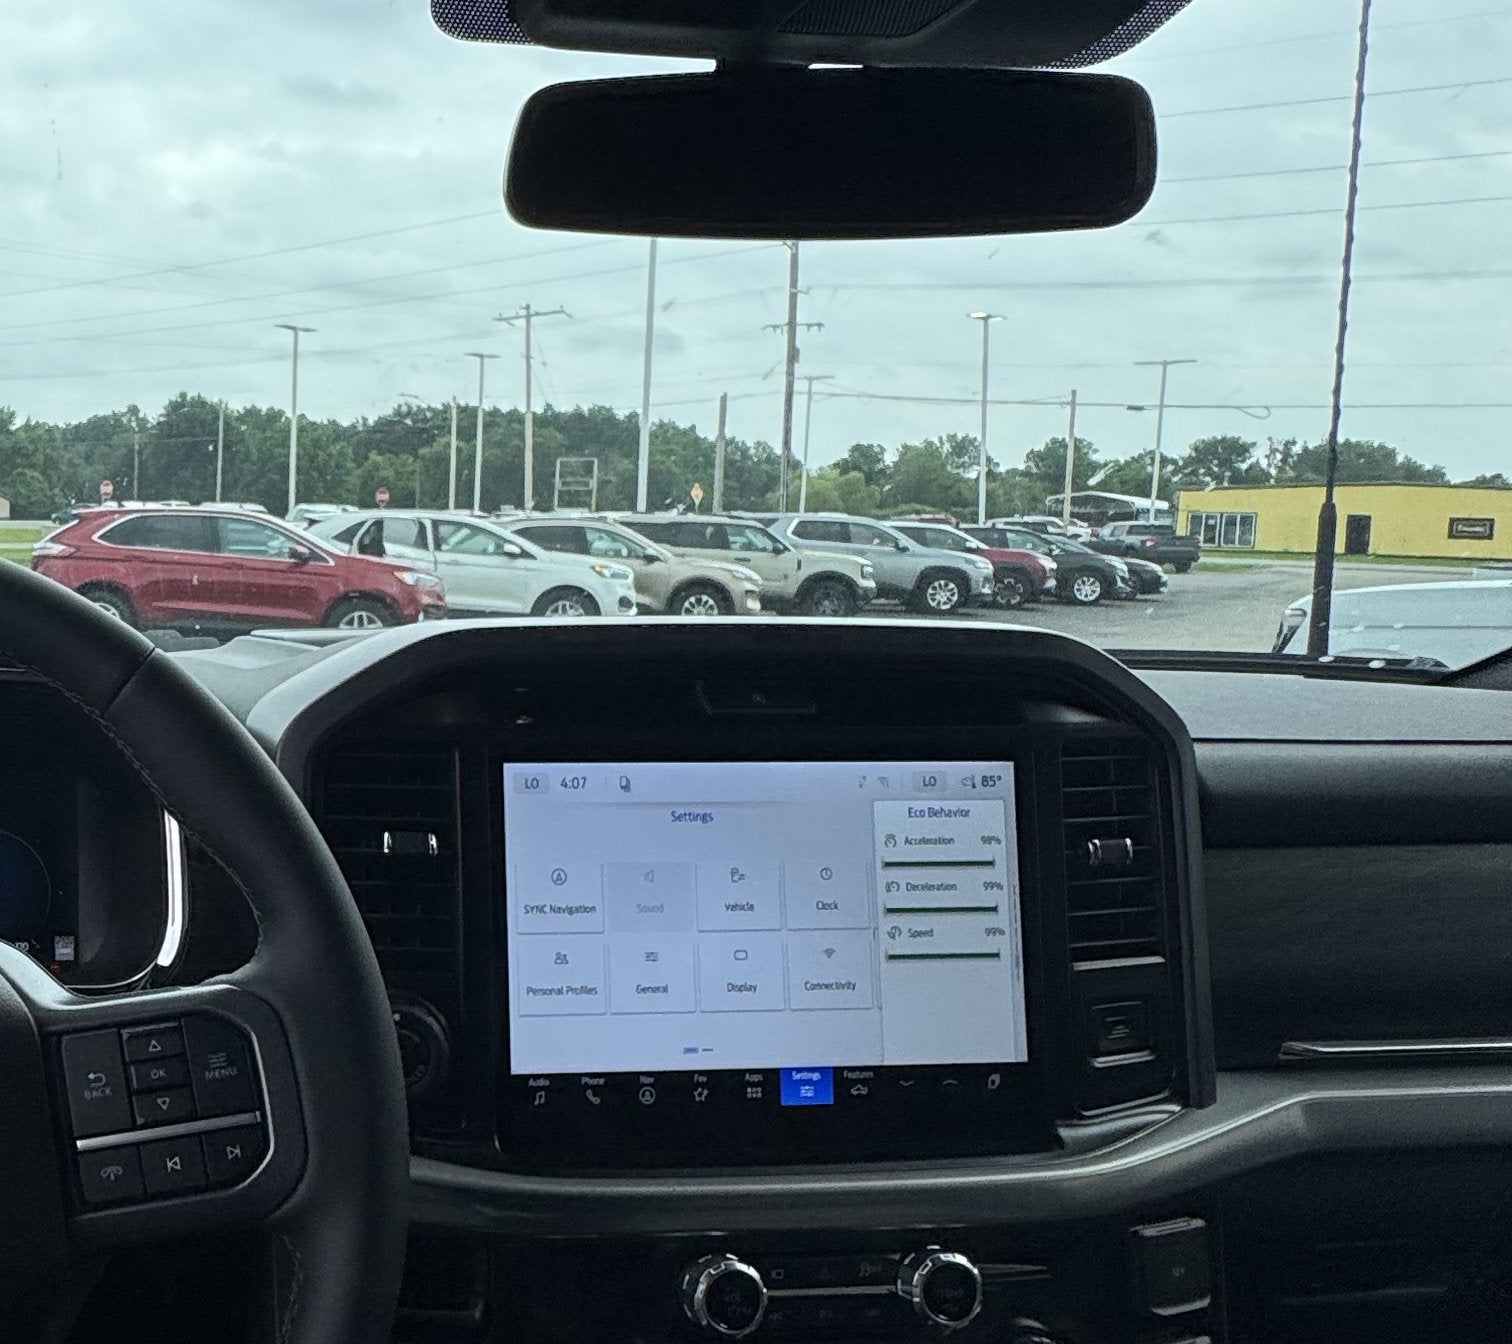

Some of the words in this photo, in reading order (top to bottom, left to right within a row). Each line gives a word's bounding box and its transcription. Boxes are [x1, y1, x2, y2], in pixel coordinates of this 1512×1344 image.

[560, 776, 587, 789] 4:07
[981, 775, 1002, 787] 85°
[671, 811, 714, 824] Settings
[908, 807, 925, 818] Eco
[928, 807, 970, 818] Behavior
[904, 837, 955, 846] Acceleration
[906, 882, 957, 892] Deceleration
[524, 904, 546, 914] SYNC
[549, 904, 596, 916] Navigation
[636, 903, 664, 913] Sound
[724, 902, 754, 912] Vehicle
[816, 900, 838, 910] Clock
[908, 928, 934, 938] Speed
[526, 986, 563, 996] Personal
[566, 985, 597, 996] Profiles
[636, 984, 669, 994] General
[727, 982, 757, 994] Display
[805, 981, 856, 993] Connectivity
[151, 1069, 166, 1078] OK
[205, 1067, 237, 1081] MENU
[694, 1074, 708, 1083] Fav
[745, 1072, 763, 1083] Apps
[791, 1071, 822, 1082] Settings
[843, 1070, 874, 1080] Features
[528, 1078, 550, 1087] Audio
[581, 1076, 605, 1086] Phone
[639, 1075, 654, 1084] Nav
[84, 1088, 112, 1099] BACK
